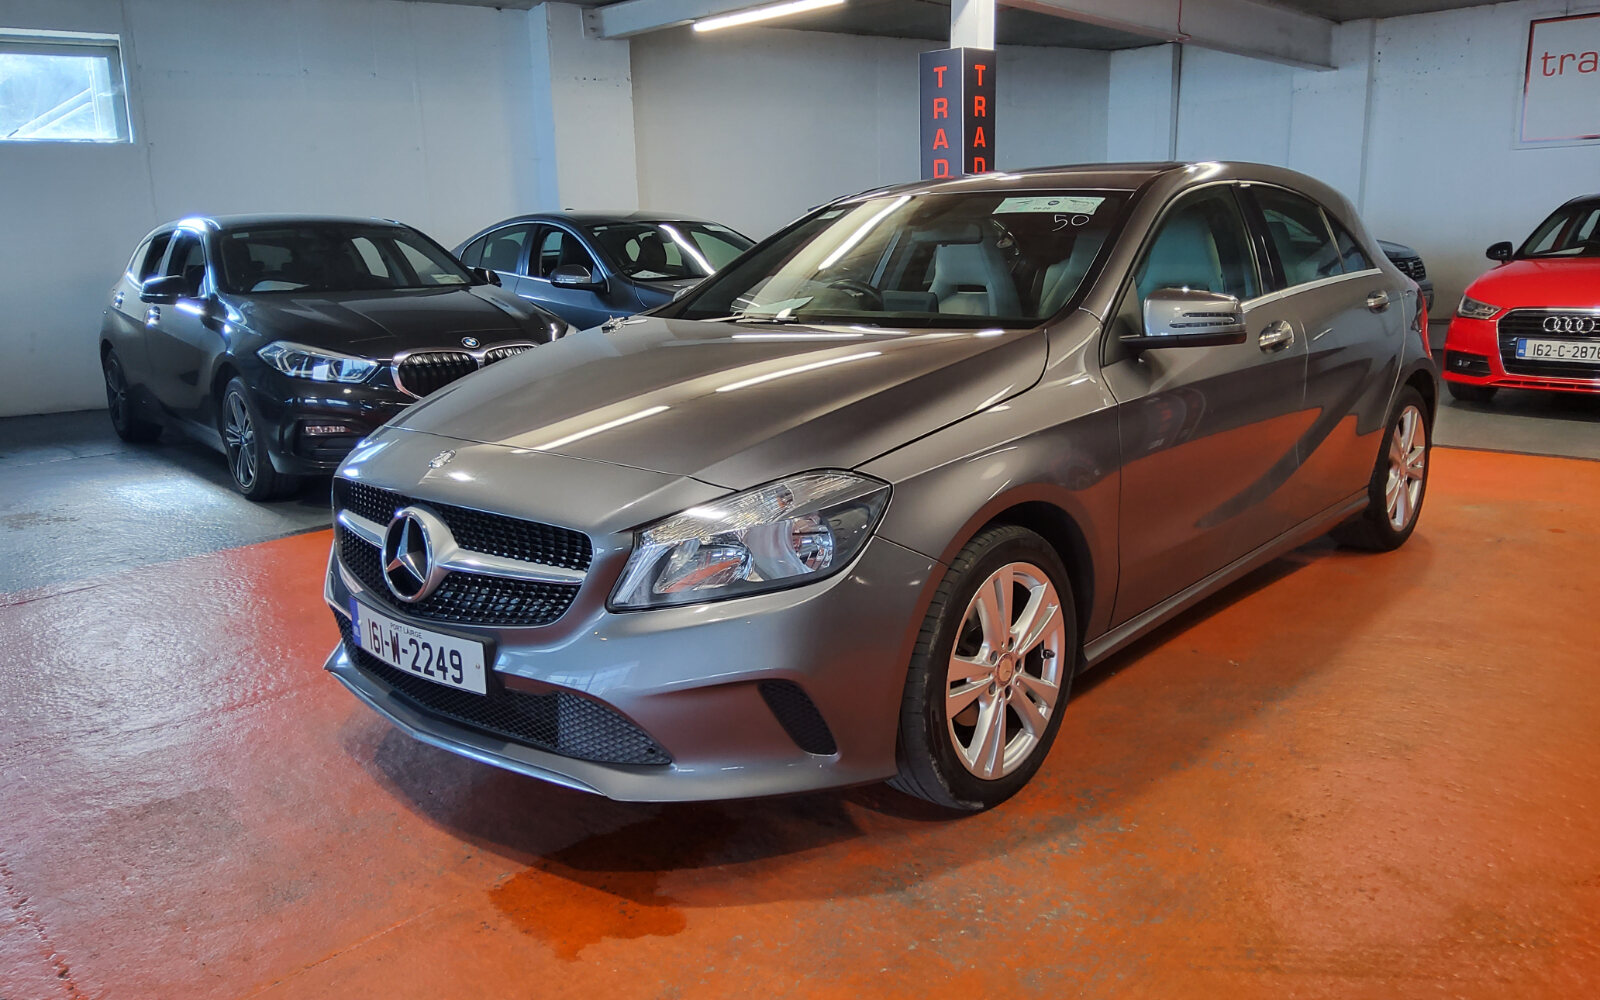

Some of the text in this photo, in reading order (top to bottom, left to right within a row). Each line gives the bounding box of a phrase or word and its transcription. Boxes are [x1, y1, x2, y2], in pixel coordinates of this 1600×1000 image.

[1541, 51, 1599, 77] tra
[1052, 214, 1090, 231] 50
[367, 618, 464, 684] 161-W-2249
